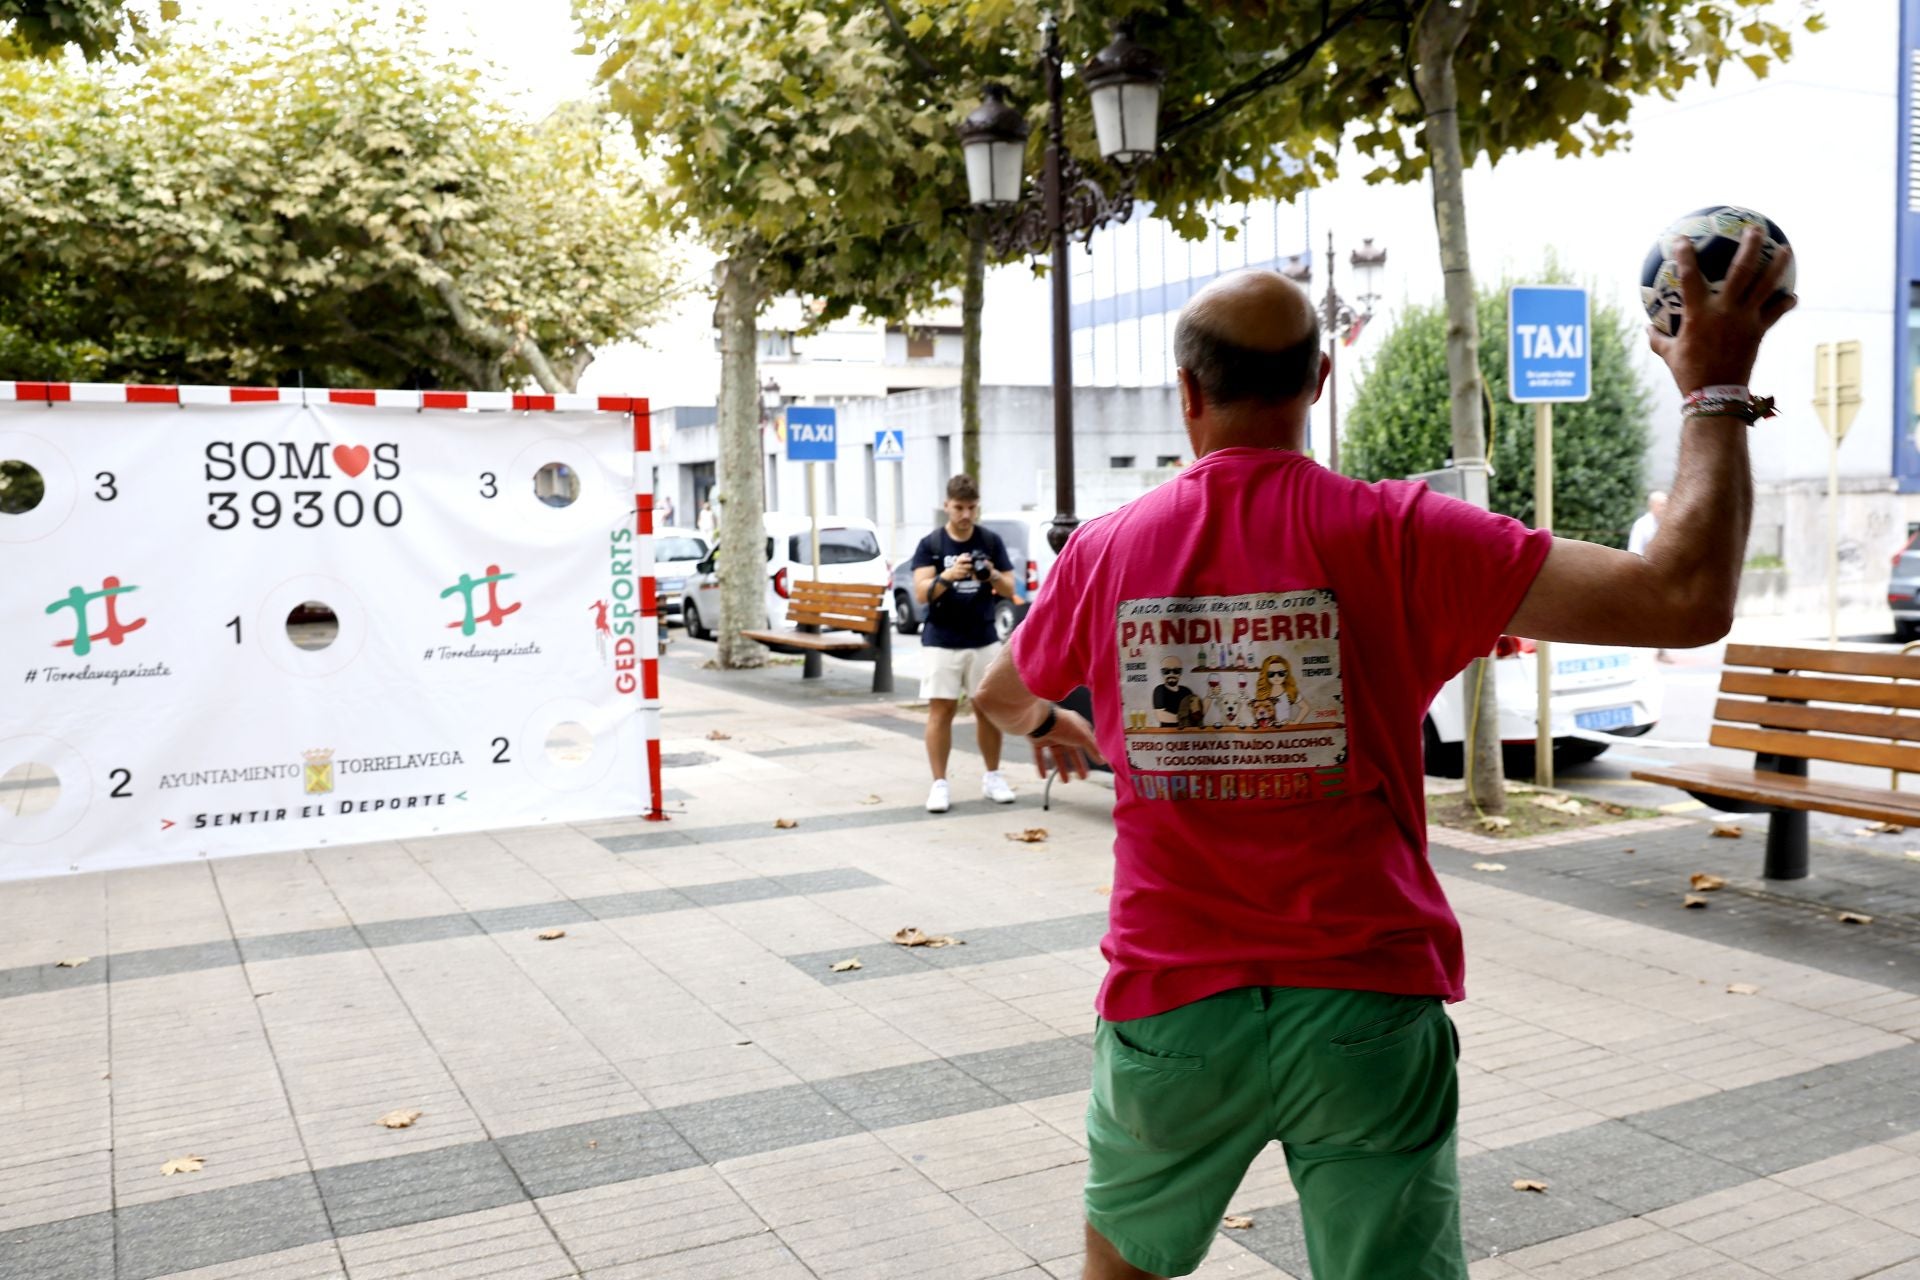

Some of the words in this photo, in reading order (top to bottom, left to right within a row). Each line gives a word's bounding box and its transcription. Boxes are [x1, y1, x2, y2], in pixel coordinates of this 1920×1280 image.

[1516, 324, 1584, 359] TAXI
[789, 423, 834, 442] TAXI
[94, 471, 118, 502] 3
[479, 471, 499, 499] 3
[207, 490, 403, 530] 39300
[611, 528, 637, 694] GEDSPORTS
[225, 615, 242, 645] 1
[1121, 618, 1221, 647] PANDI
[1231, 611, 1331, 644] PERRI
[491, 736, 511, 764] 2
[1131, 741, 1164, 751] ESPERO
[1165, 740, 1190, 752] QUE
[1191, 740, 1231, 751] HAYAS
[1275, 736, 1335, 750] ALCOHOL
[1163, 754, 1230, 766] GOLOSINAS
[1232, 755, 1262, 765] PARA
[1263, 753, 1309, 764] PERROS
[109, 767, 133, 799] 2
[158, 764, 300, 790] AYUNTAMIENTO
[337, 750, 464, 775] TORRELAVEGA
